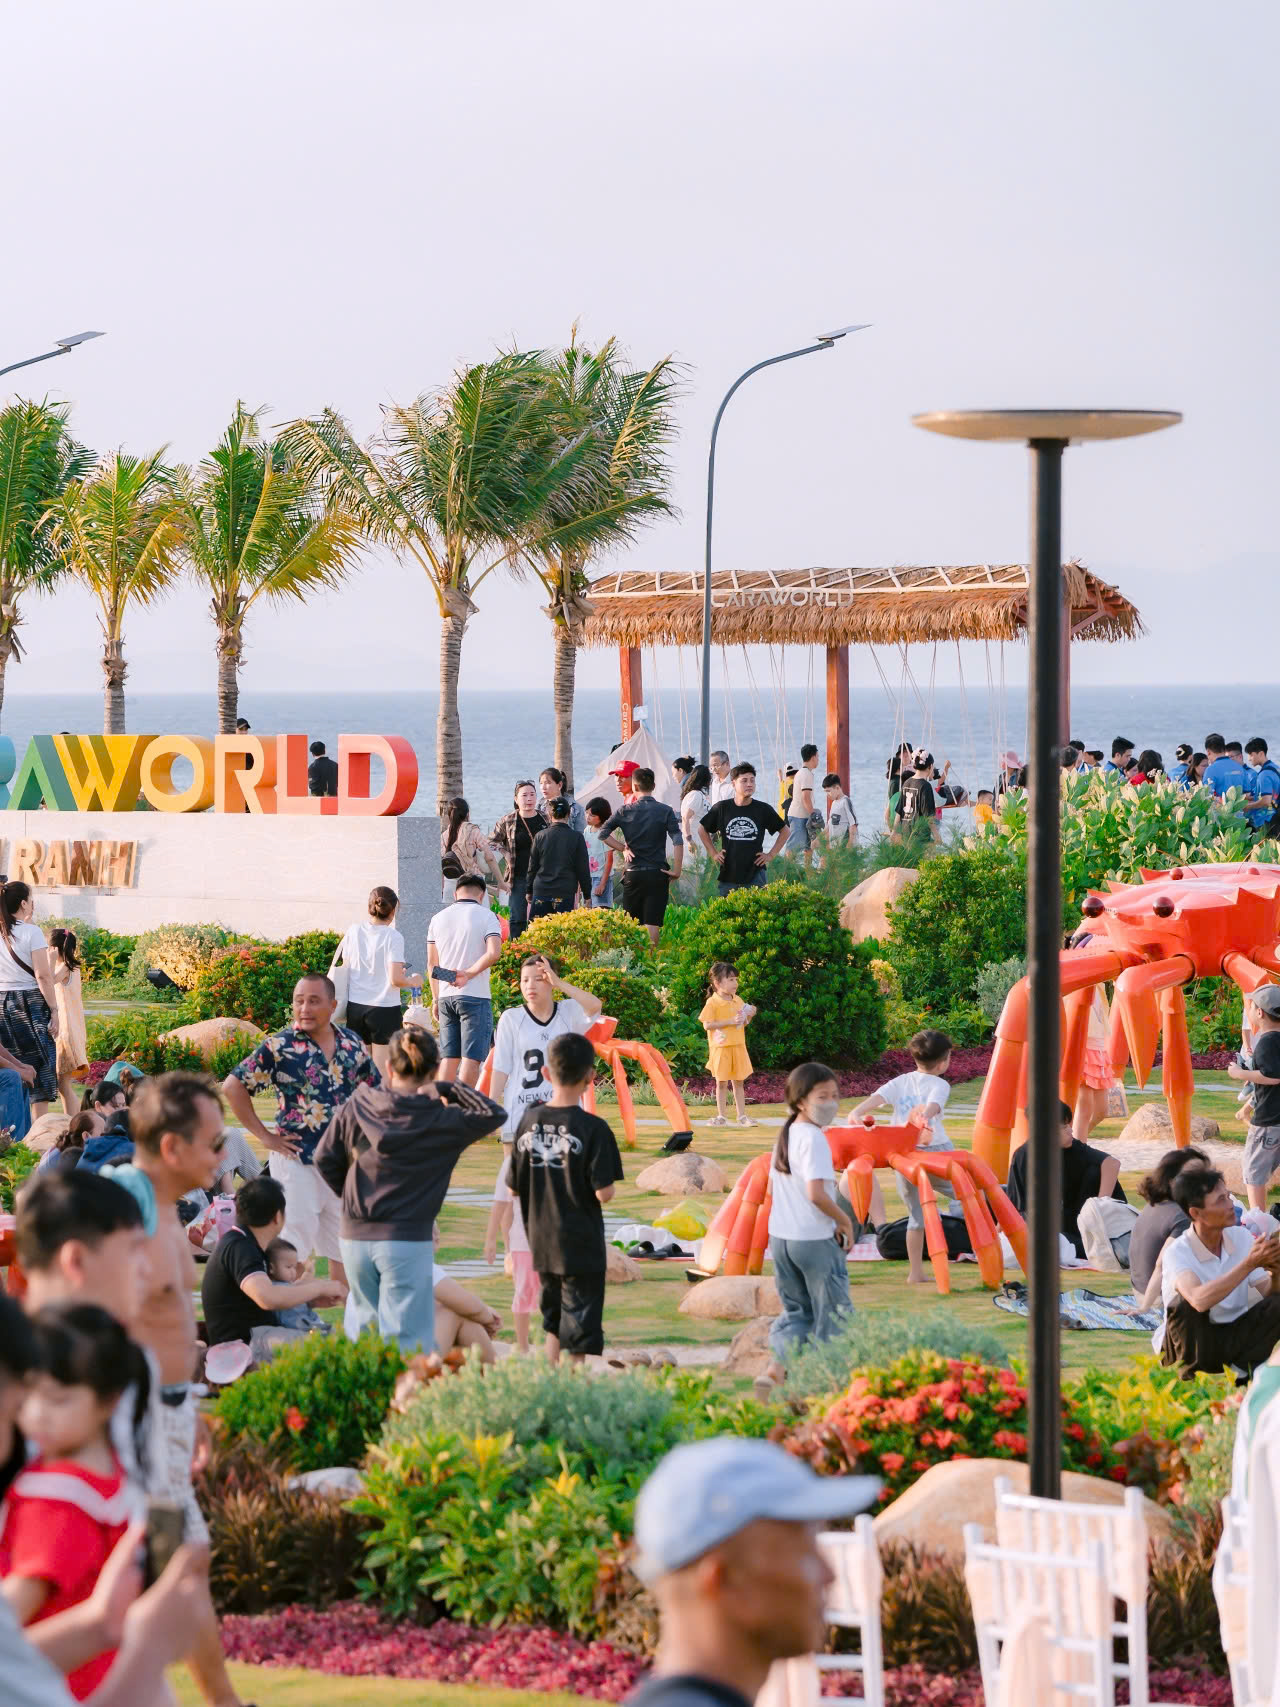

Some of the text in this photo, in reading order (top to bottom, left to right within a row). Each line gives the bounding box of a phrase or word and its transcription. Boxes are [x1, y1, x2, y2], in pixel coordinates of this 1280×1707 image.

[710, 588, 854, 607] CARAWORLD
[12, 839, 138, 888] RANH
[522, 1049, 544, 1089] 9
